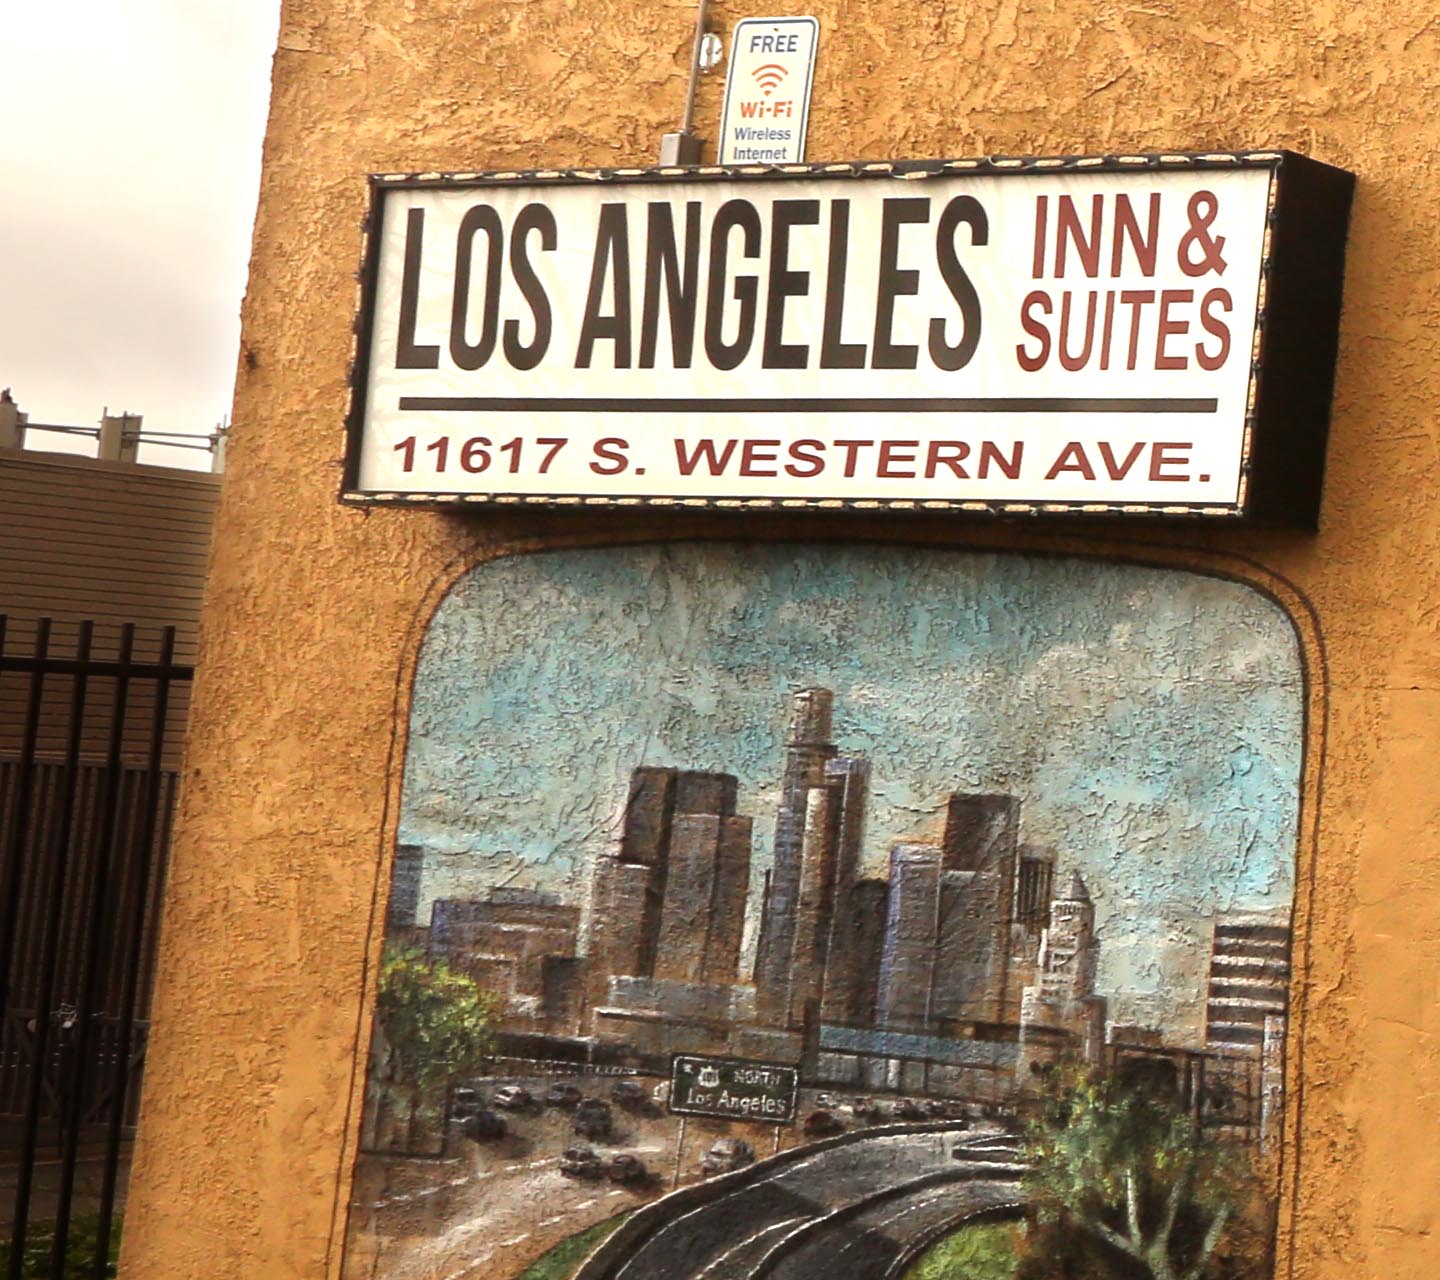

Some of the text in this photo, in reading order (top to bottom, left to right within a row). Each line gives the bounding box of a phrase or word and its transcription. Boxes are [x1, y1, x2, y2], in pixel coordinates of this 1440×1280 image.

[749, 34, 799, 54] FREE
[739, 100, 793, 119] Wi-Fi
[734, 126, 792, 141] Wireless
[733, 146, 788, 161] Internet
[1031, 189, 1229, 280] INN &
[395, 194, 989, 372] LOS ANGELES
[1015, 287, 1234, 373] SUITES
[393, 435, 1212, 483] 11617 S. WESTERN AVE.
[733, 1068, 781, 1087] NORTH
[686, 1087, 787, 1115] Los Angeles
